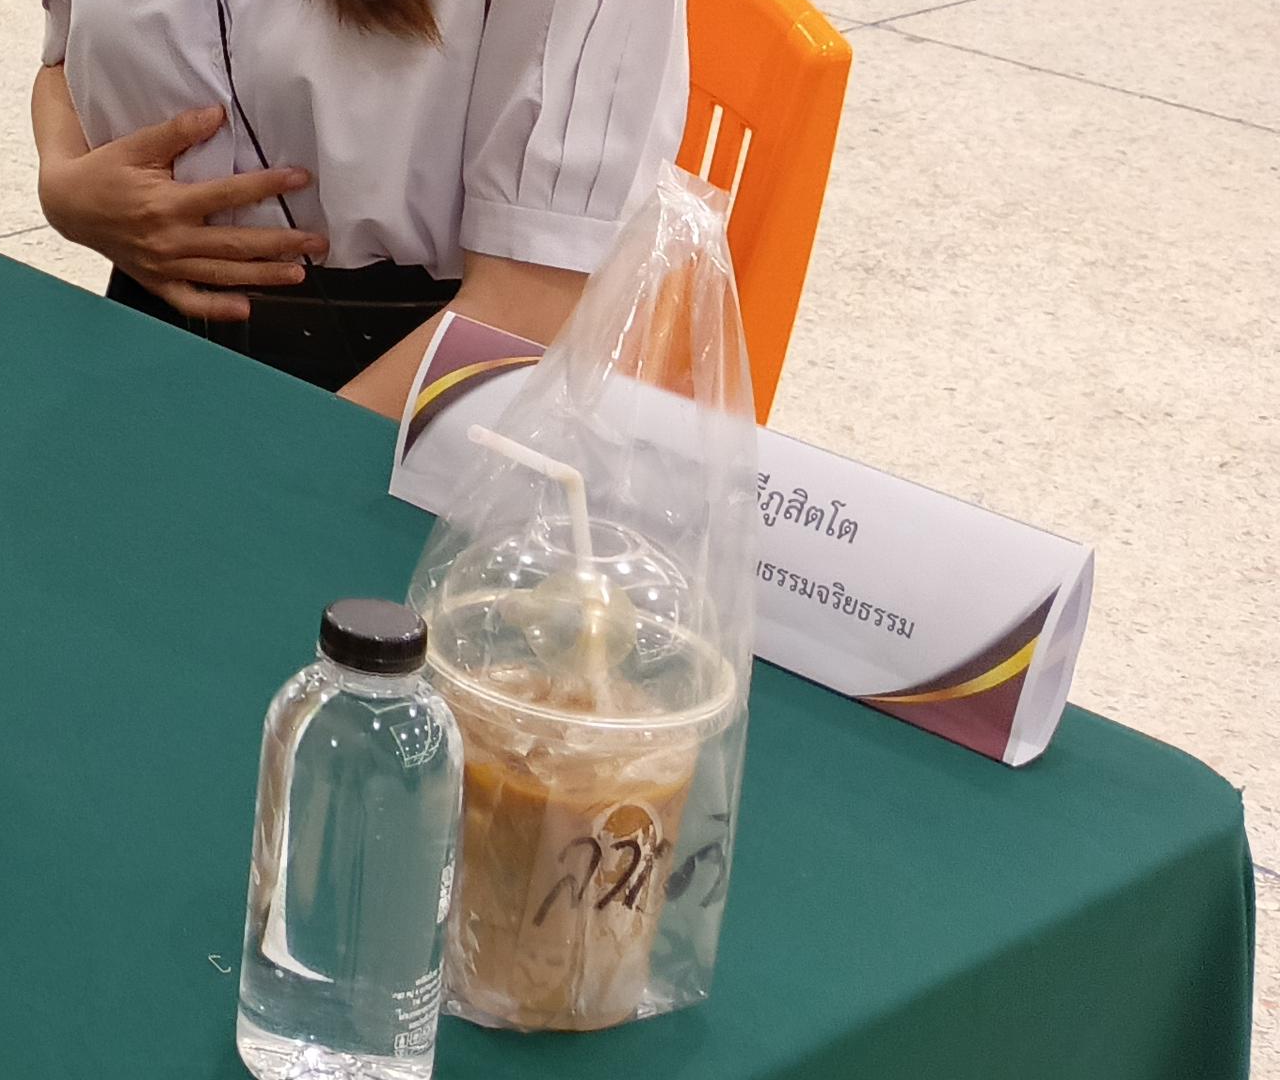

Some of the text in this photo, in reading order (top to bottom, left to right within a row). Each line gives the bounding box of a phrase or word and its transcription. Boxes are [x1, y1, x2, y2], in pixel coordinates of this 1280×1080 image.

[756, 560, 915, 639] ธรรมจริยธรรม
